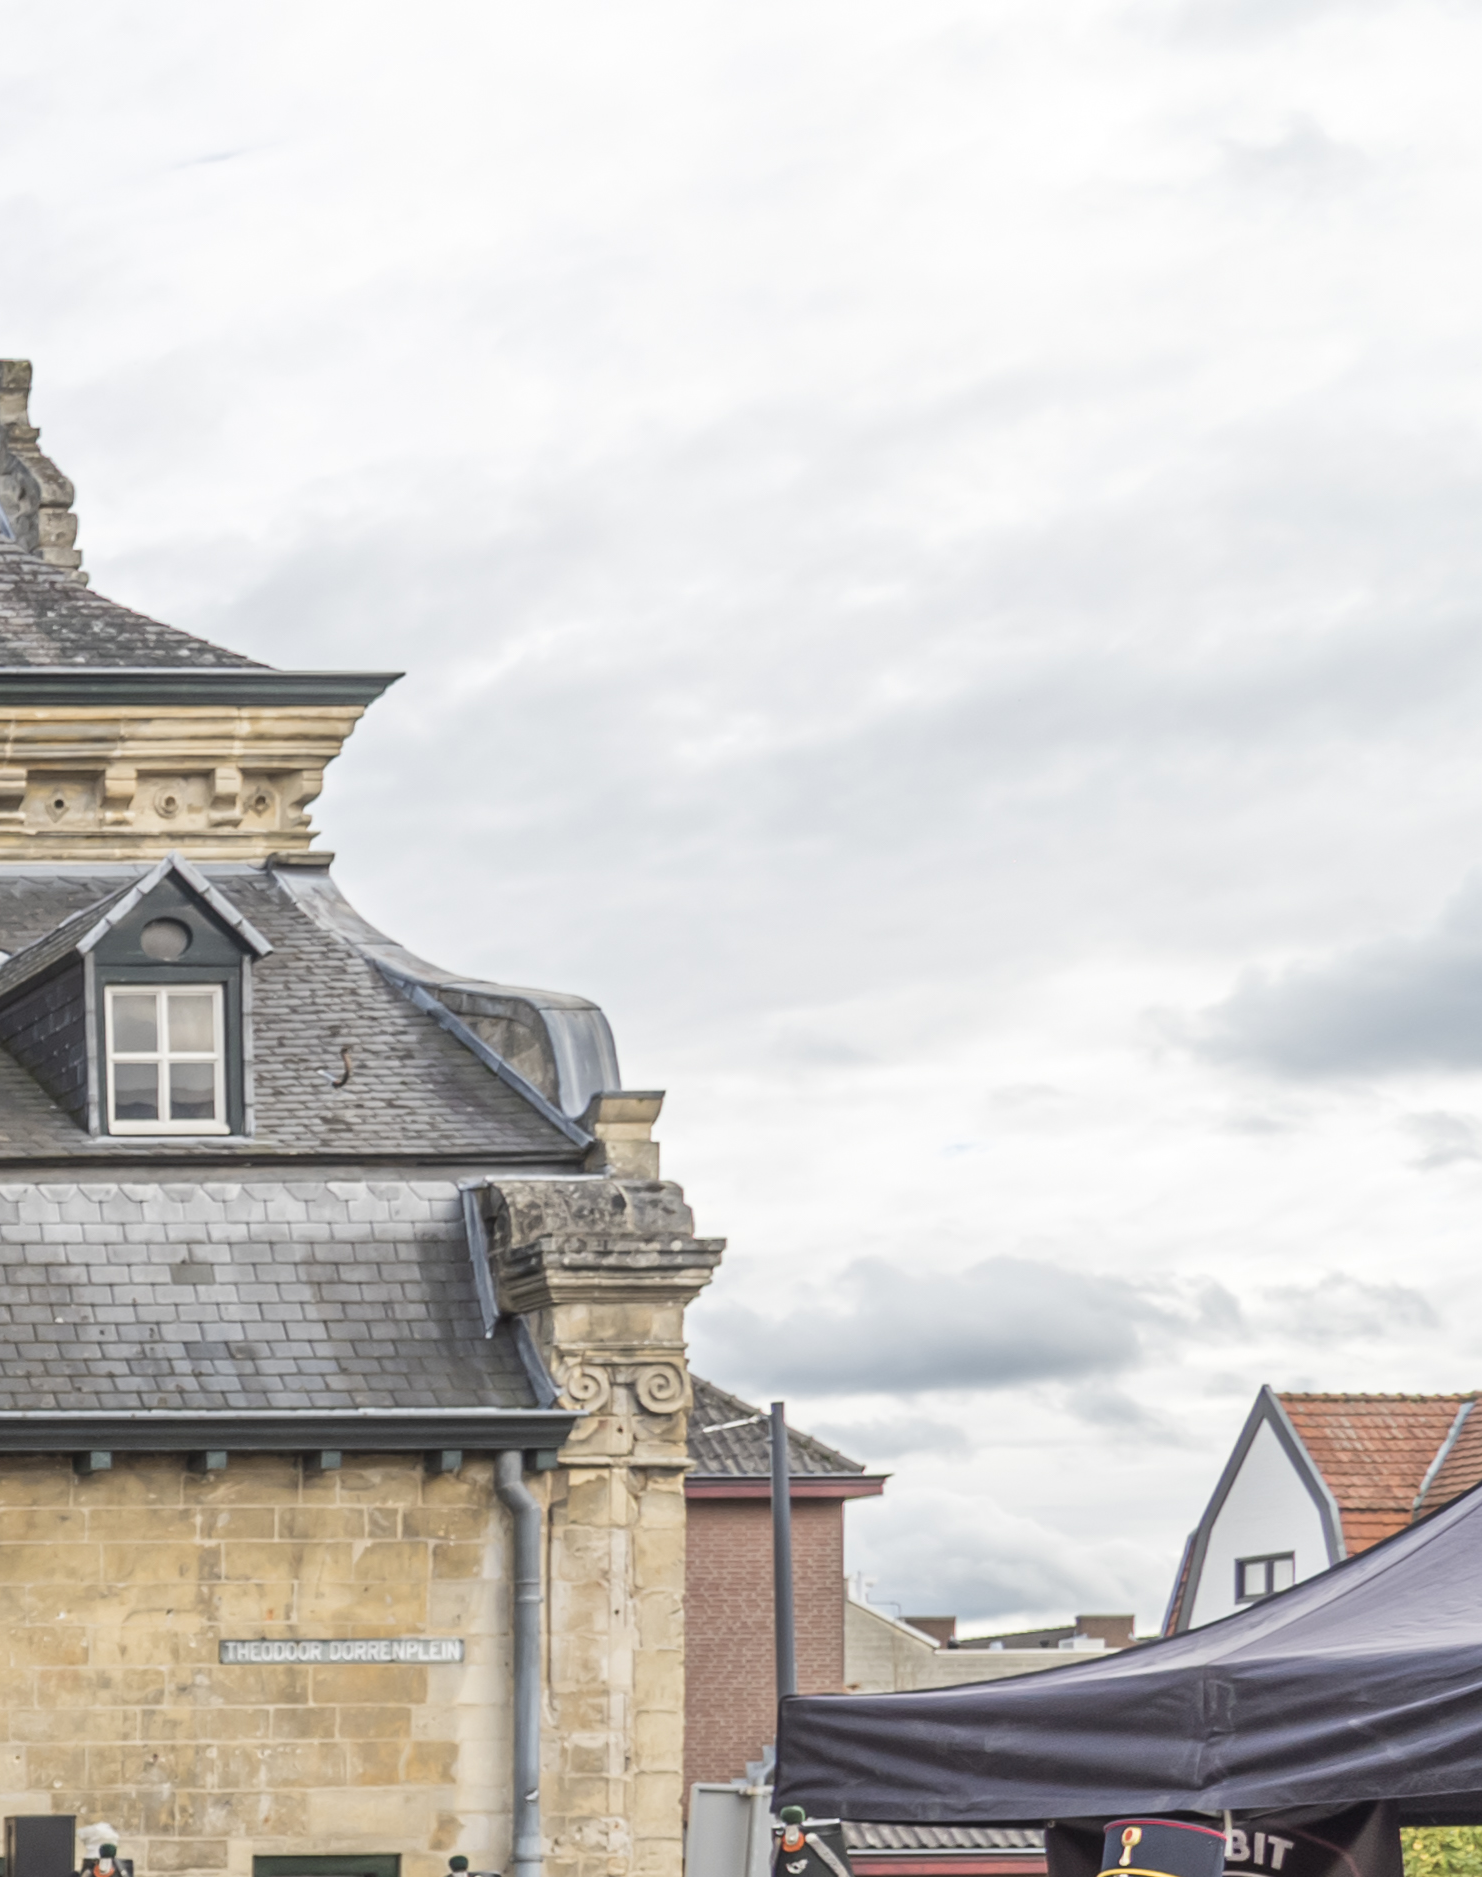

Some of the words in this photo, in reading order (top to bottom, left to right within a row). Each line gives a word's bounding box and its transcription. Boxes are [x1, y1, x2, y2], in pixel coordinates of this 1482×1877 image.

[225, 1641, 322, 1661] THEODOOR
[329, 1640, 461, 1661] DORRENPLEIN
[1224, 1829, 1295, 1870] BIT
